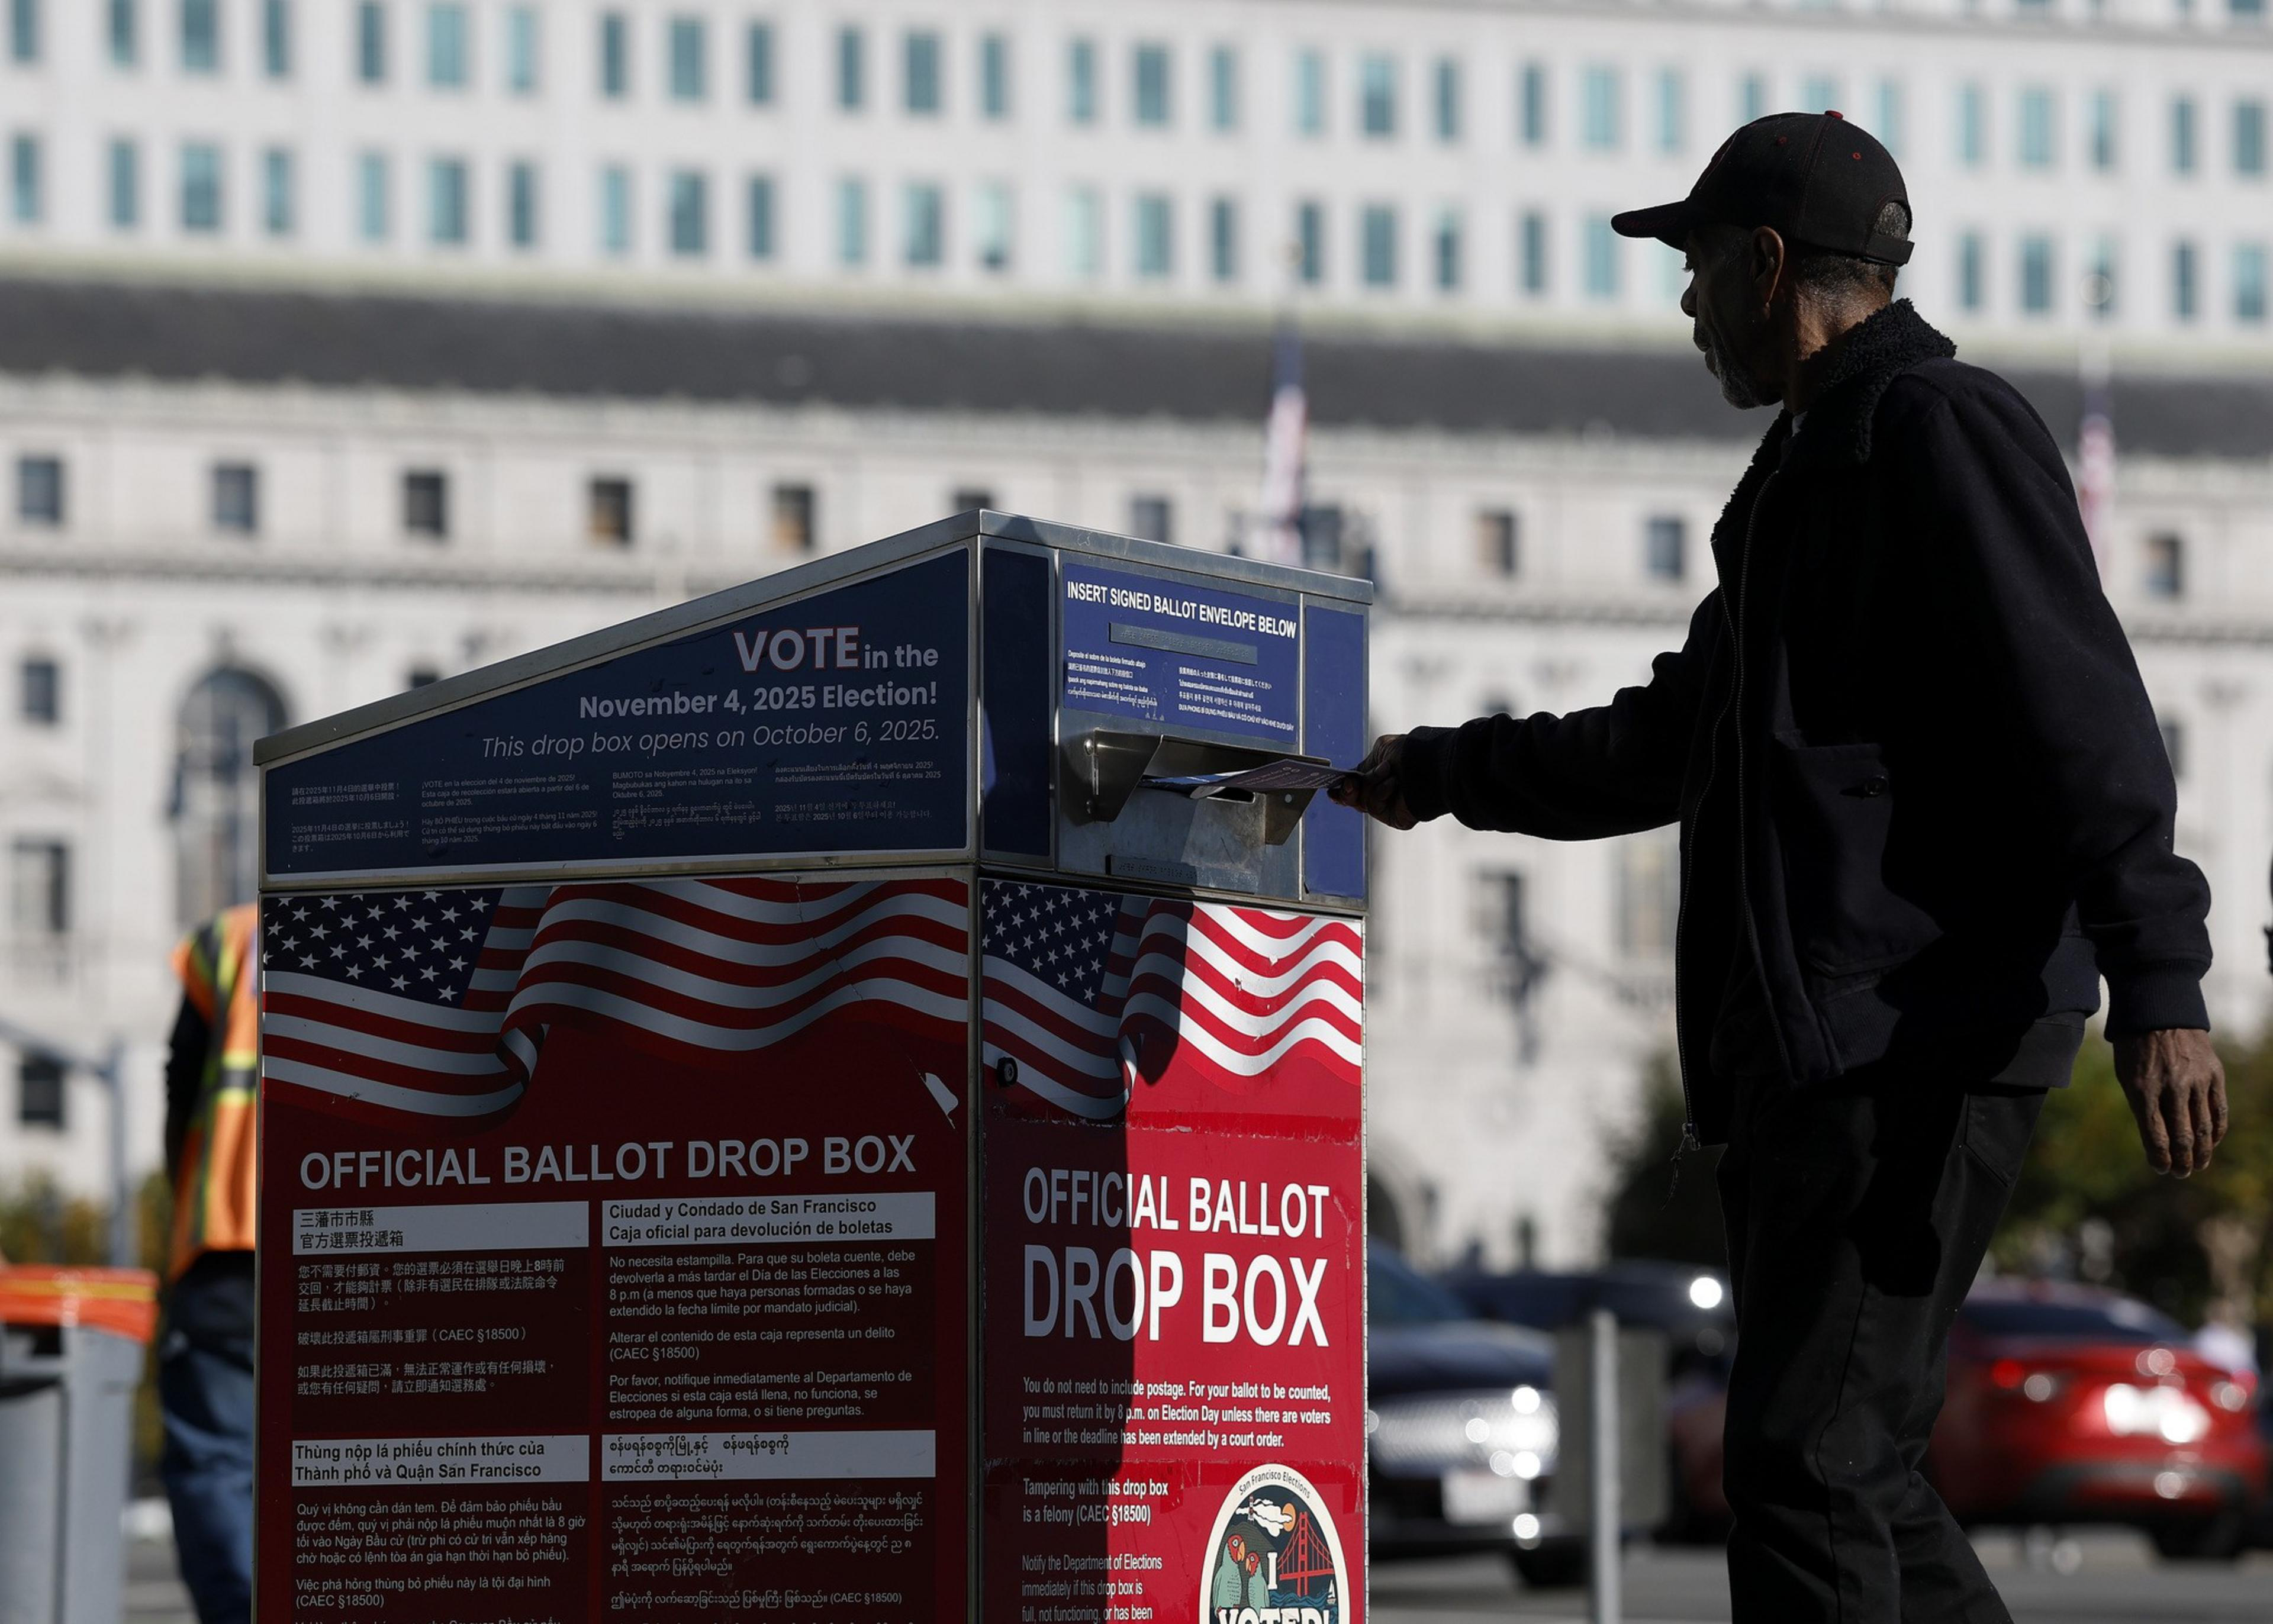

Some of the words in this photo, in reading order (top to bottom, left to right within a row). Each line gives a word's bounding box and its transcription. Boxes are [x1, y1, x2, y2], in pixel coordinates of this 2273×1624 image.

[1067, 581, 1107, 603] INSERT
[1110, 588, 1151, 611] SIGNED
[1154, 595, 1197, 619] BALLOT
[1199, 604, 1255, 630] ENVELOPE
[1258, 615, 1296, 638] BELOW
[735, 626, 859, 672] VOTE
[865, 645, 887, 669] in
[894, 645, 939, 669] the
[580, 691, 717, 718] November
[723, 689, 746, 715] 4,
[754, 685, 815, 710] 2025
[823, 681, 936, 707] Election!
[482, 736, 524, 759] This
[532, 734, 584, 760] drop
[591, 732, 632, 752] box
[639, 732, 708, 756] opens
[716, 730, 744, 747] on
[753, 723, 847, 745] October
[854, 721, 871, 745] 6,
[879, 718, 938, 740] 2025.
[300, 1148, 490, 1189] OFFICIAL
[504, 1141, 673, 1183] BALLOT
[688, 1138, 808, 1177] DROP
[824, 1135, 916, 1174] BOX
[610, 1203, 660, 1219] Ciudad
[665, 1206, 673, 1220] y
[678, 1201, 743, 1216] Condado
[748, 1201, 765, 1214] de
[771, 1200, 797, 1214] San
[803, 1198, 876, 1213] Francisco
[1023, 1167, 1179, 1230] OFFICIAL
[1189, 1177, 1329, 1239] BALLOT
[300, 1210, 374, 1227] 三藩市市縣
[300, 1230, 403, 1249] 官方選票投遞箱
[610, 1226, 640, 1243] Caja
[646, 1224, 688, 1239] oficial
[694, 1226, 725, 1240] para
[730, 1221, 810, 1236] devolución
[816, 1220, 833, 1235] de
[839, 1220, 892, 1234] boletas
[1023, 1244, 1184, 1341] DROP
[1202, 1252, 1329, 1347] BOX
[609, 1332, 645, 1343] Alterar
[648, 1331, 658, 1342] el
[661, 1330, 713, 1342] contenido
[717, 1330, 730, 1341] de
[733, 1330, 756, 1341] esta
[760, 1328, 782, 1342] caja
[785, 1328, 844, 1342] representa
[848, 1329, 861, 1338] un
[865, 1327, 894, 1338] delito
[610, 1347, 649, 1362] (CAEC
[652, 1346, 699, 1361] §18500)
[1023, 1377, 1040, 1393] You
[1043, 1377, 1054, 1393] do
[1057, 1378, 1072, 1393] not
[1075, 1378, 1096, 1394] need
[1099, 1380, 1108, 1394] to
[1111, 1378, 1144, 1395] include
[1147, 1381, 1186, 1400] postage.
[1189, 1380, 1205, 1396] For
[1207, 1385, 1229, 1400] your
[1231, 1381, 1258, 1398] ballot
[1260, 1383, 1270, 1398] to
[1273, 1383, 1285, 1399] be
[1288, 1384, 1330, 1402] counted,
[1023, 1406, 1039, 1422] you
[1042, 1403, 1064, 1418] must
[1067, 1404, 1093, 1418] return
[1096, 1403, 1102, 1419] it
[1104, 1403, 1115, 1423] by
[1118, 1404, 1122, 1419] 8
[1126, 1407, 1145, 1423] p.m.
[1147, 1408, 1159, 1420] on
[1161, 1404, 1199, 1420] Election
[1201, 1405, 1219, 1425] Day
[1221, 1406, 1253, 1422] unless
[1254, 1406, 1280, 1422] there
[1282, 1410, 1298, 1423] are
[1299, 1409, 1331, 1423] voters
[1023, 1427, 1031, 1443] in
[1034, 1427, 1049, 1443] line
[1052, 1431, 1062, 1443] or
[1064, 1428, 1078, 1443] the
[1080, 1428, 1117, 1443] deadline
[1121, 1429, 1136, 1444] has
[1138, 1428, 1161, 1445] been
[1163, 1429, 1205, 1445] extended
[1207, 1429, 1219, 1449] by
[1221, 1433, 1226, 1445] a
[1229, 1431, 1254, 1446] court
[1256, 1430, 1284, 1446] order.
[295, 1445, 340, 1462] Thùng
[345, 1444, 372, 1461] nộp
[376, 1443, 388, 1457] lá
[393, 1441, 432, 1460] phiếu
[437, 1442, 476, 1457] chính
[481, 1441, 514, 1455] thức
[519, 1441, 544, 1455] của
[294, 1465, 339, 1480] Thành
[344, 1462, 371, 1483] phố
[375, 1464, 391, 1478] và
[396, 1464, 433, 1481] Quận
[439, 1463, 465, 1478] San
[471, 1462, 540, 1477] Francisco
[1023, 1478, 1075, 1499] Tampering
[1077, 1478, 1098, 1495] with
[1102, 1478, 1120, 1495] this
[1122, 1478, 1147, 1499] drop
[1149, 1478, 1168, 1495] box
[1239, 1481, 1251, 1496] San
[1251, 1470, 1282, 1486] Francisco
[1283, 1472, 1311, 1499] Elections
[1023, 1505, 1031, 1522] is
[1034, 1509, 1040, 1522] a
[1042, 1504, 1073, 1526] felony
[1076, 1504, 1109, 1526] (CAEC
[1112, 1504, 1150, 1526] §18500)
[1022, 1554, 1046, 1574] Notify
[1048, 1555, 1061, 1570] the
[1063, 1554, 1112, 1574] Department
[1113, 1553, 1122, 1570] of
[1123, 1553, 1162, 1570] Elections
[1267, 1552, 1278, 1590] I
[1022, 1580, 1071, 1600] immediately
[1074, 1579, 1078, 1595] if
[1080, 1580, 1095, 1596] this
[1097, 1580, 1116, 1599] drop
[1118, 1578, 1134, 1595] box
[1135, 1578, 1142, 1595] is
